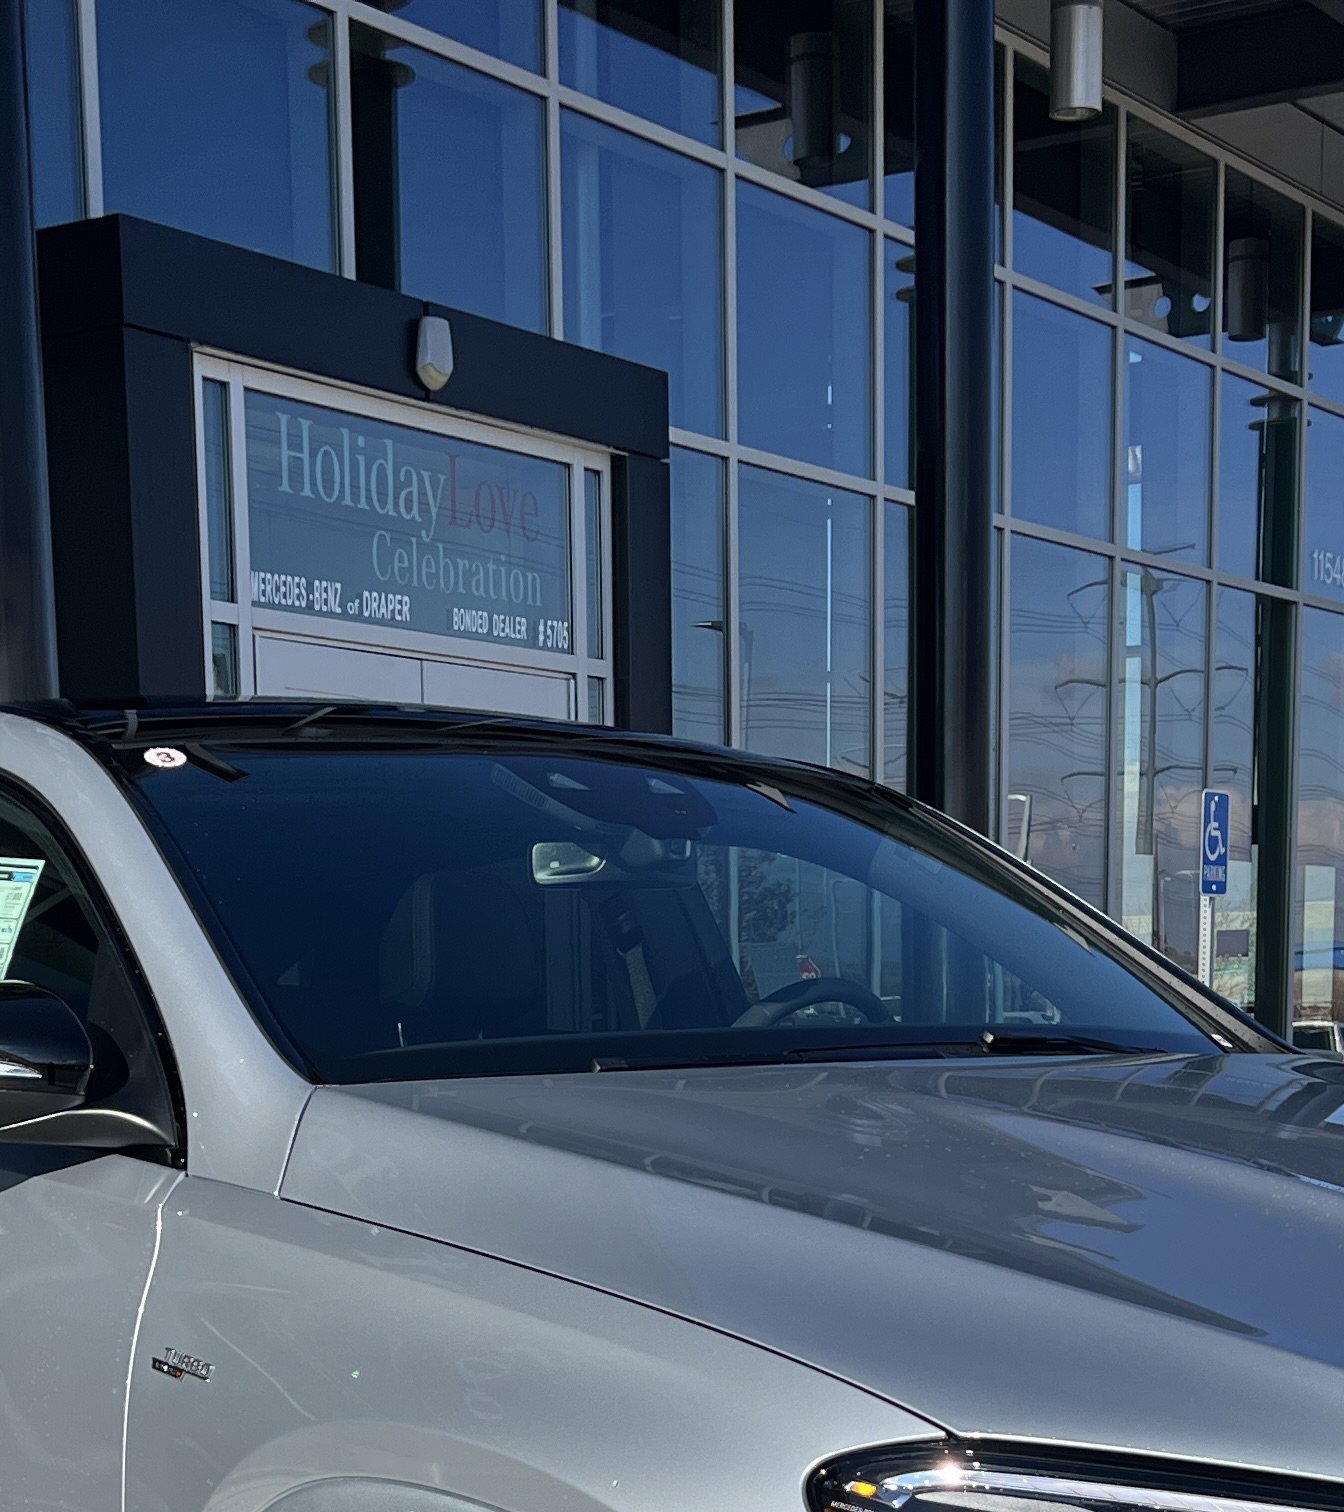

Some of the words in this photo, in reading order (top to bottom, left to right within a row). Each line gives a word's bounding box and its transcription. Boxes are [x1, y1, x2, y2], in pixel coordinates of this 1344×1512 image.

[371, 530, 544, 608] Celebration
[346, 598, 360, 615] of
[362, 590, 411, 622] DRAPER
[452, 607, 489, 634] BONDED
[492, 613, 528, 640] DEALER
